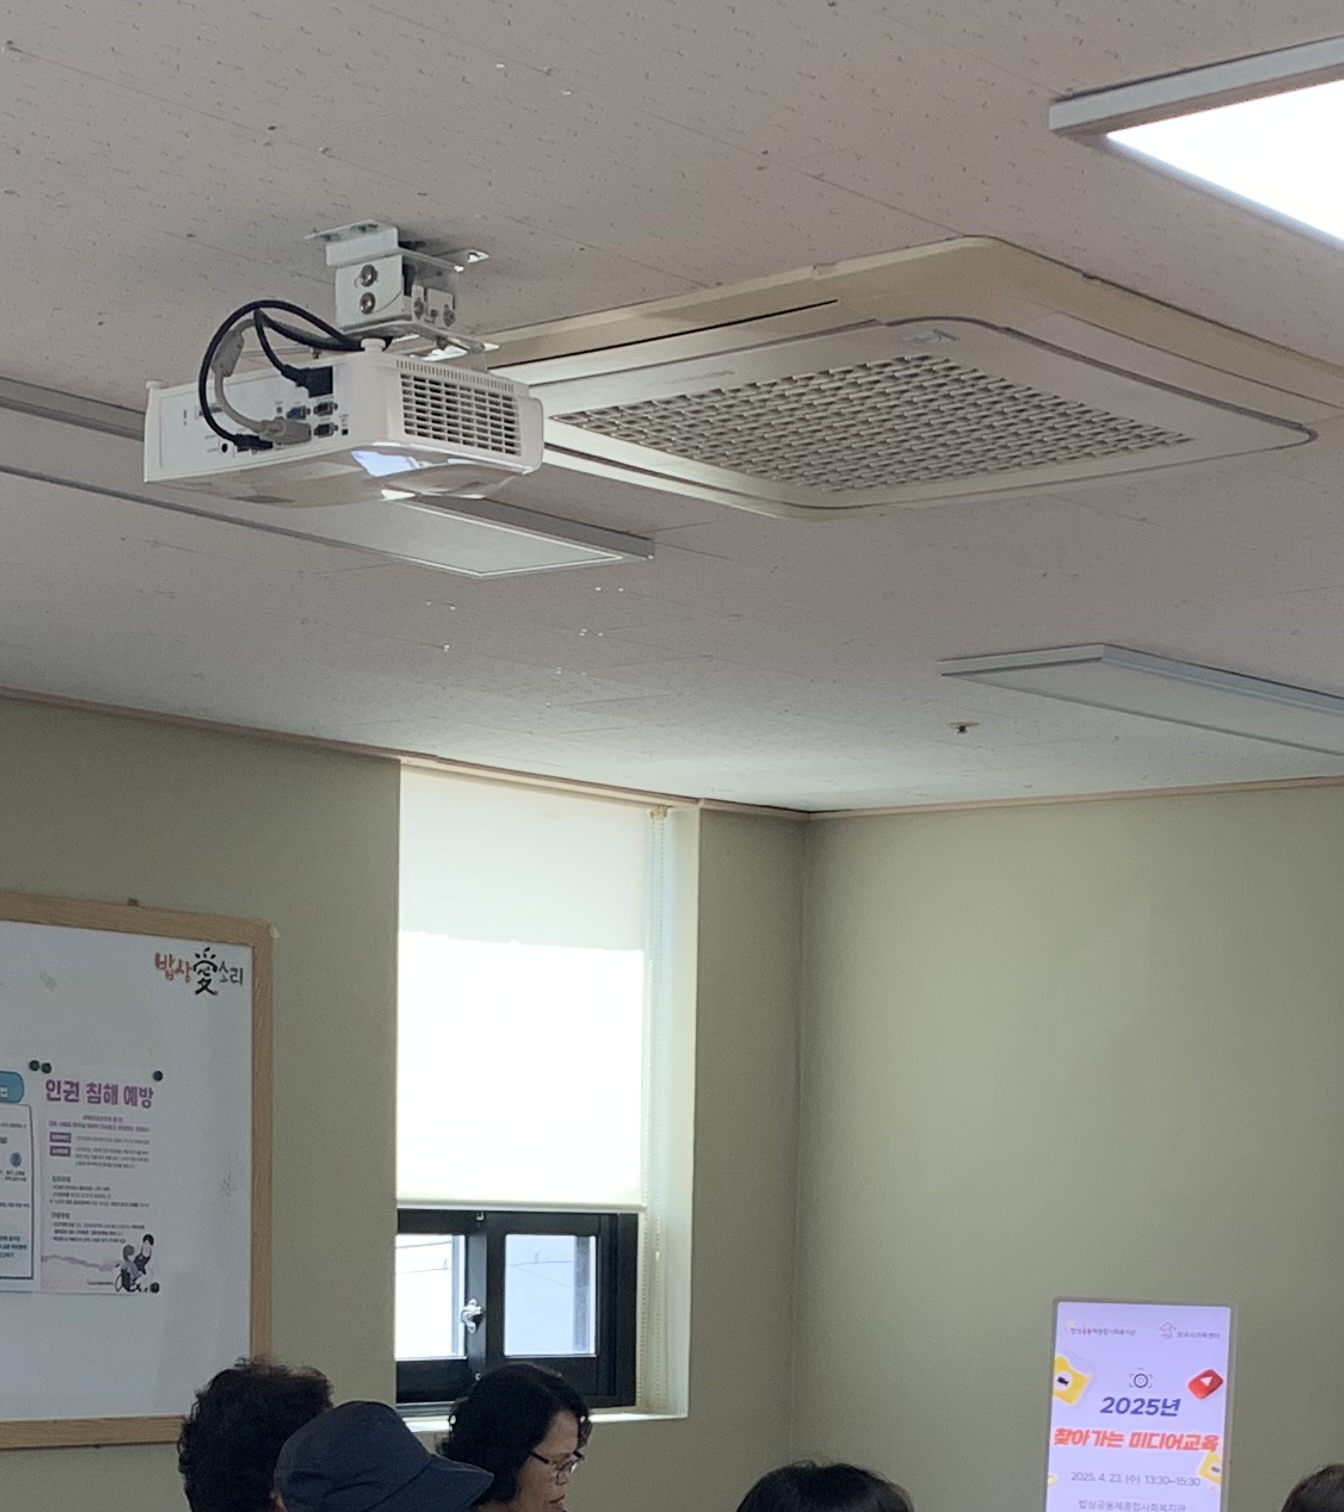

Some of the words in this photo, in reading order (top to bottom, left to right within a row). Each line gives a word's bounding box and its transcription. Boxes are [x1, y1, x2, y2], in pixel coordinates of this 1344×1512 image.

[45, 1079, 80, 1103] 인권
[86, 1081, 119, 1106] 침해
[123, 1085, 154, 1110] 예방
[1100, 1396, 1182, 1417] 2025년
[1054, 1427, 1125, 1448] 찾아가는
[1129, 1430, 1220, 1452] 미디어교육
